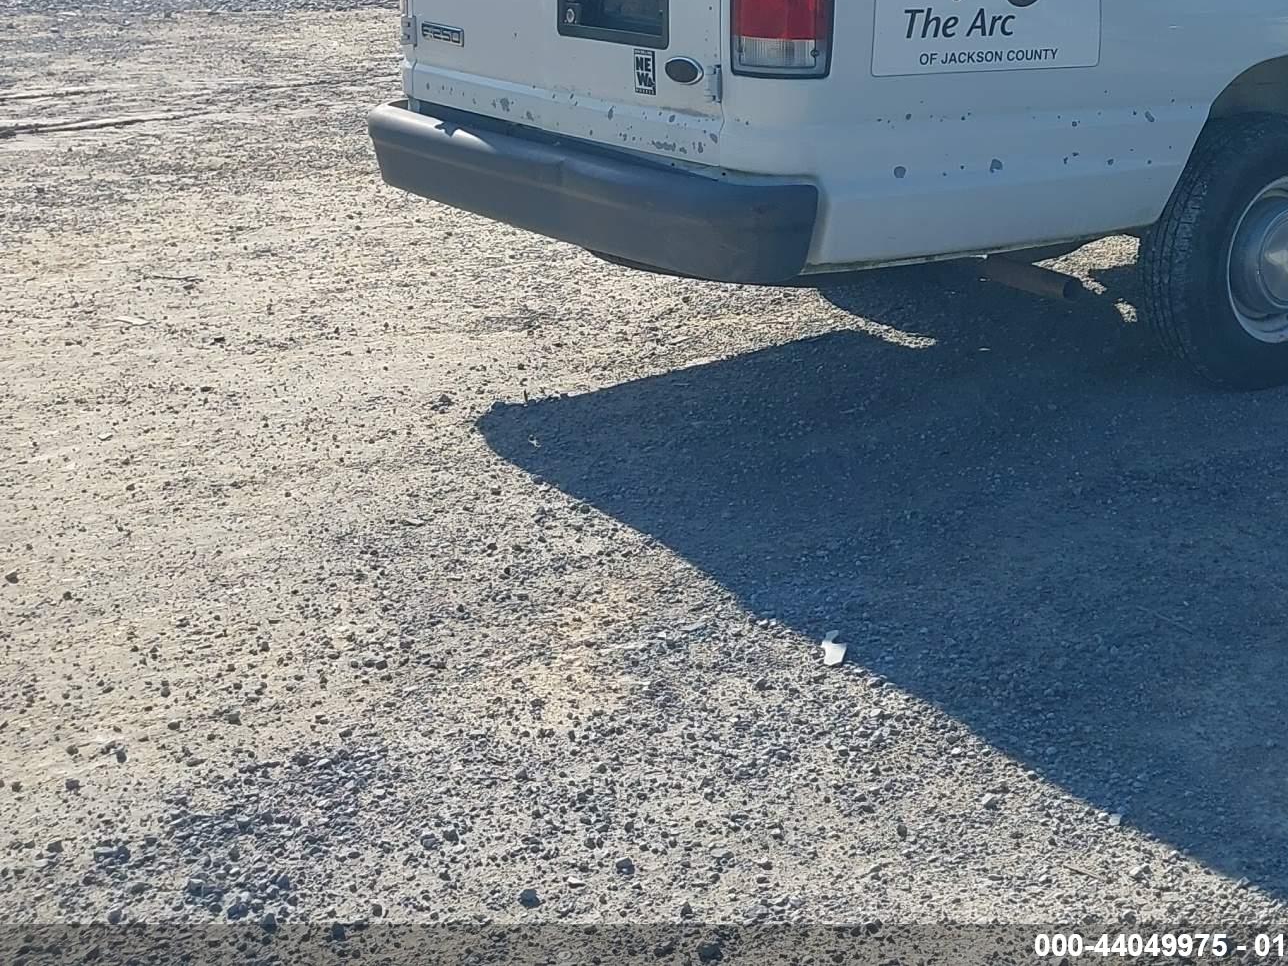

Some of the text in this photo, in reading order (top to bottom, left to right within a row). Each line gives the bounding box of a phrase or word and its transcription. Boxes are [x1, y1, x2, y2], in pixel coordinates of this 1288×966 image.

[904, 7, 1016, 39] The Arc
[919, 48, 1059, 66] OF JACKSON COUNTY
